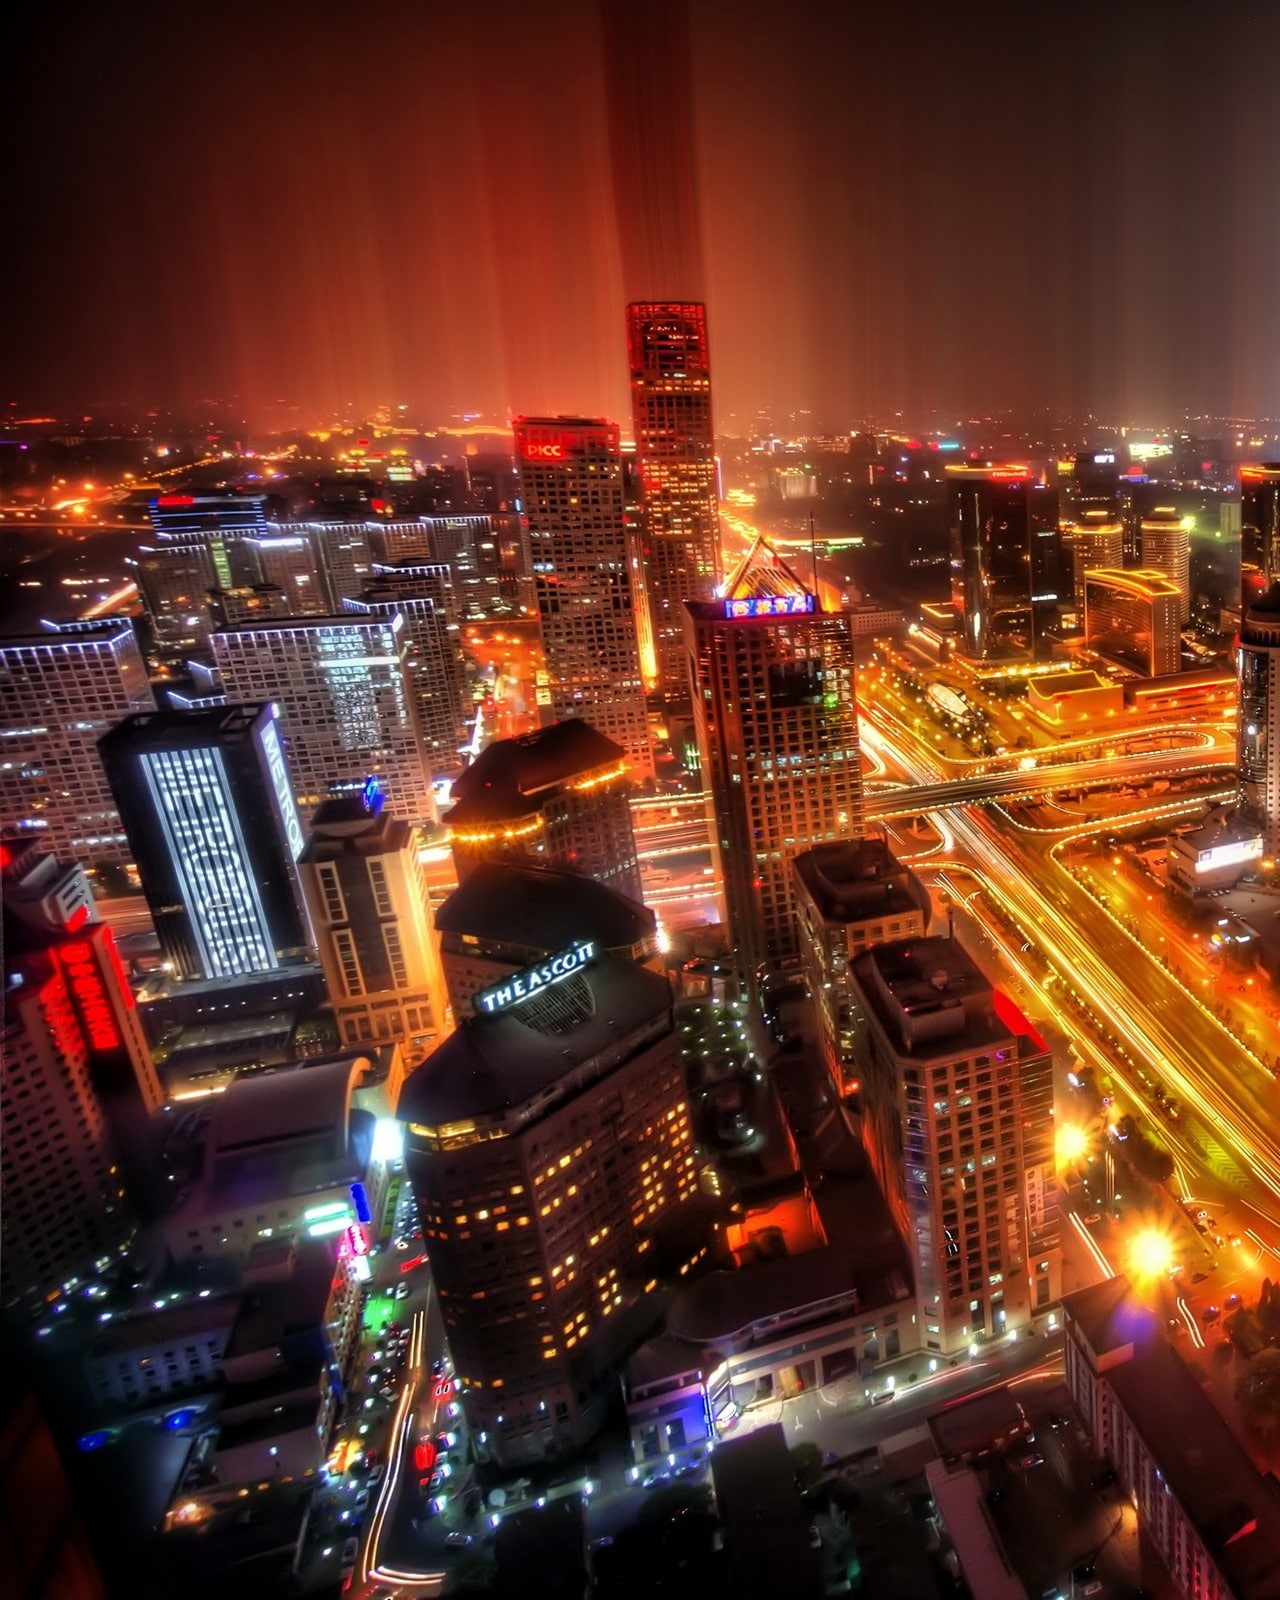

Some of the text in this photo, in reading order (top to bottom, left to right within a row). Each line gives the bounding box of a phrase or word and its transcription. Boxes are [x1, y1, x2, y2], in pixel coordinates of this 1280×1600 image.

[527, 444, 562, 457] PICC
[154, 757, 269, 970] METROPOLIS
[483, 942, 594, 1012] THE ASCOTT
